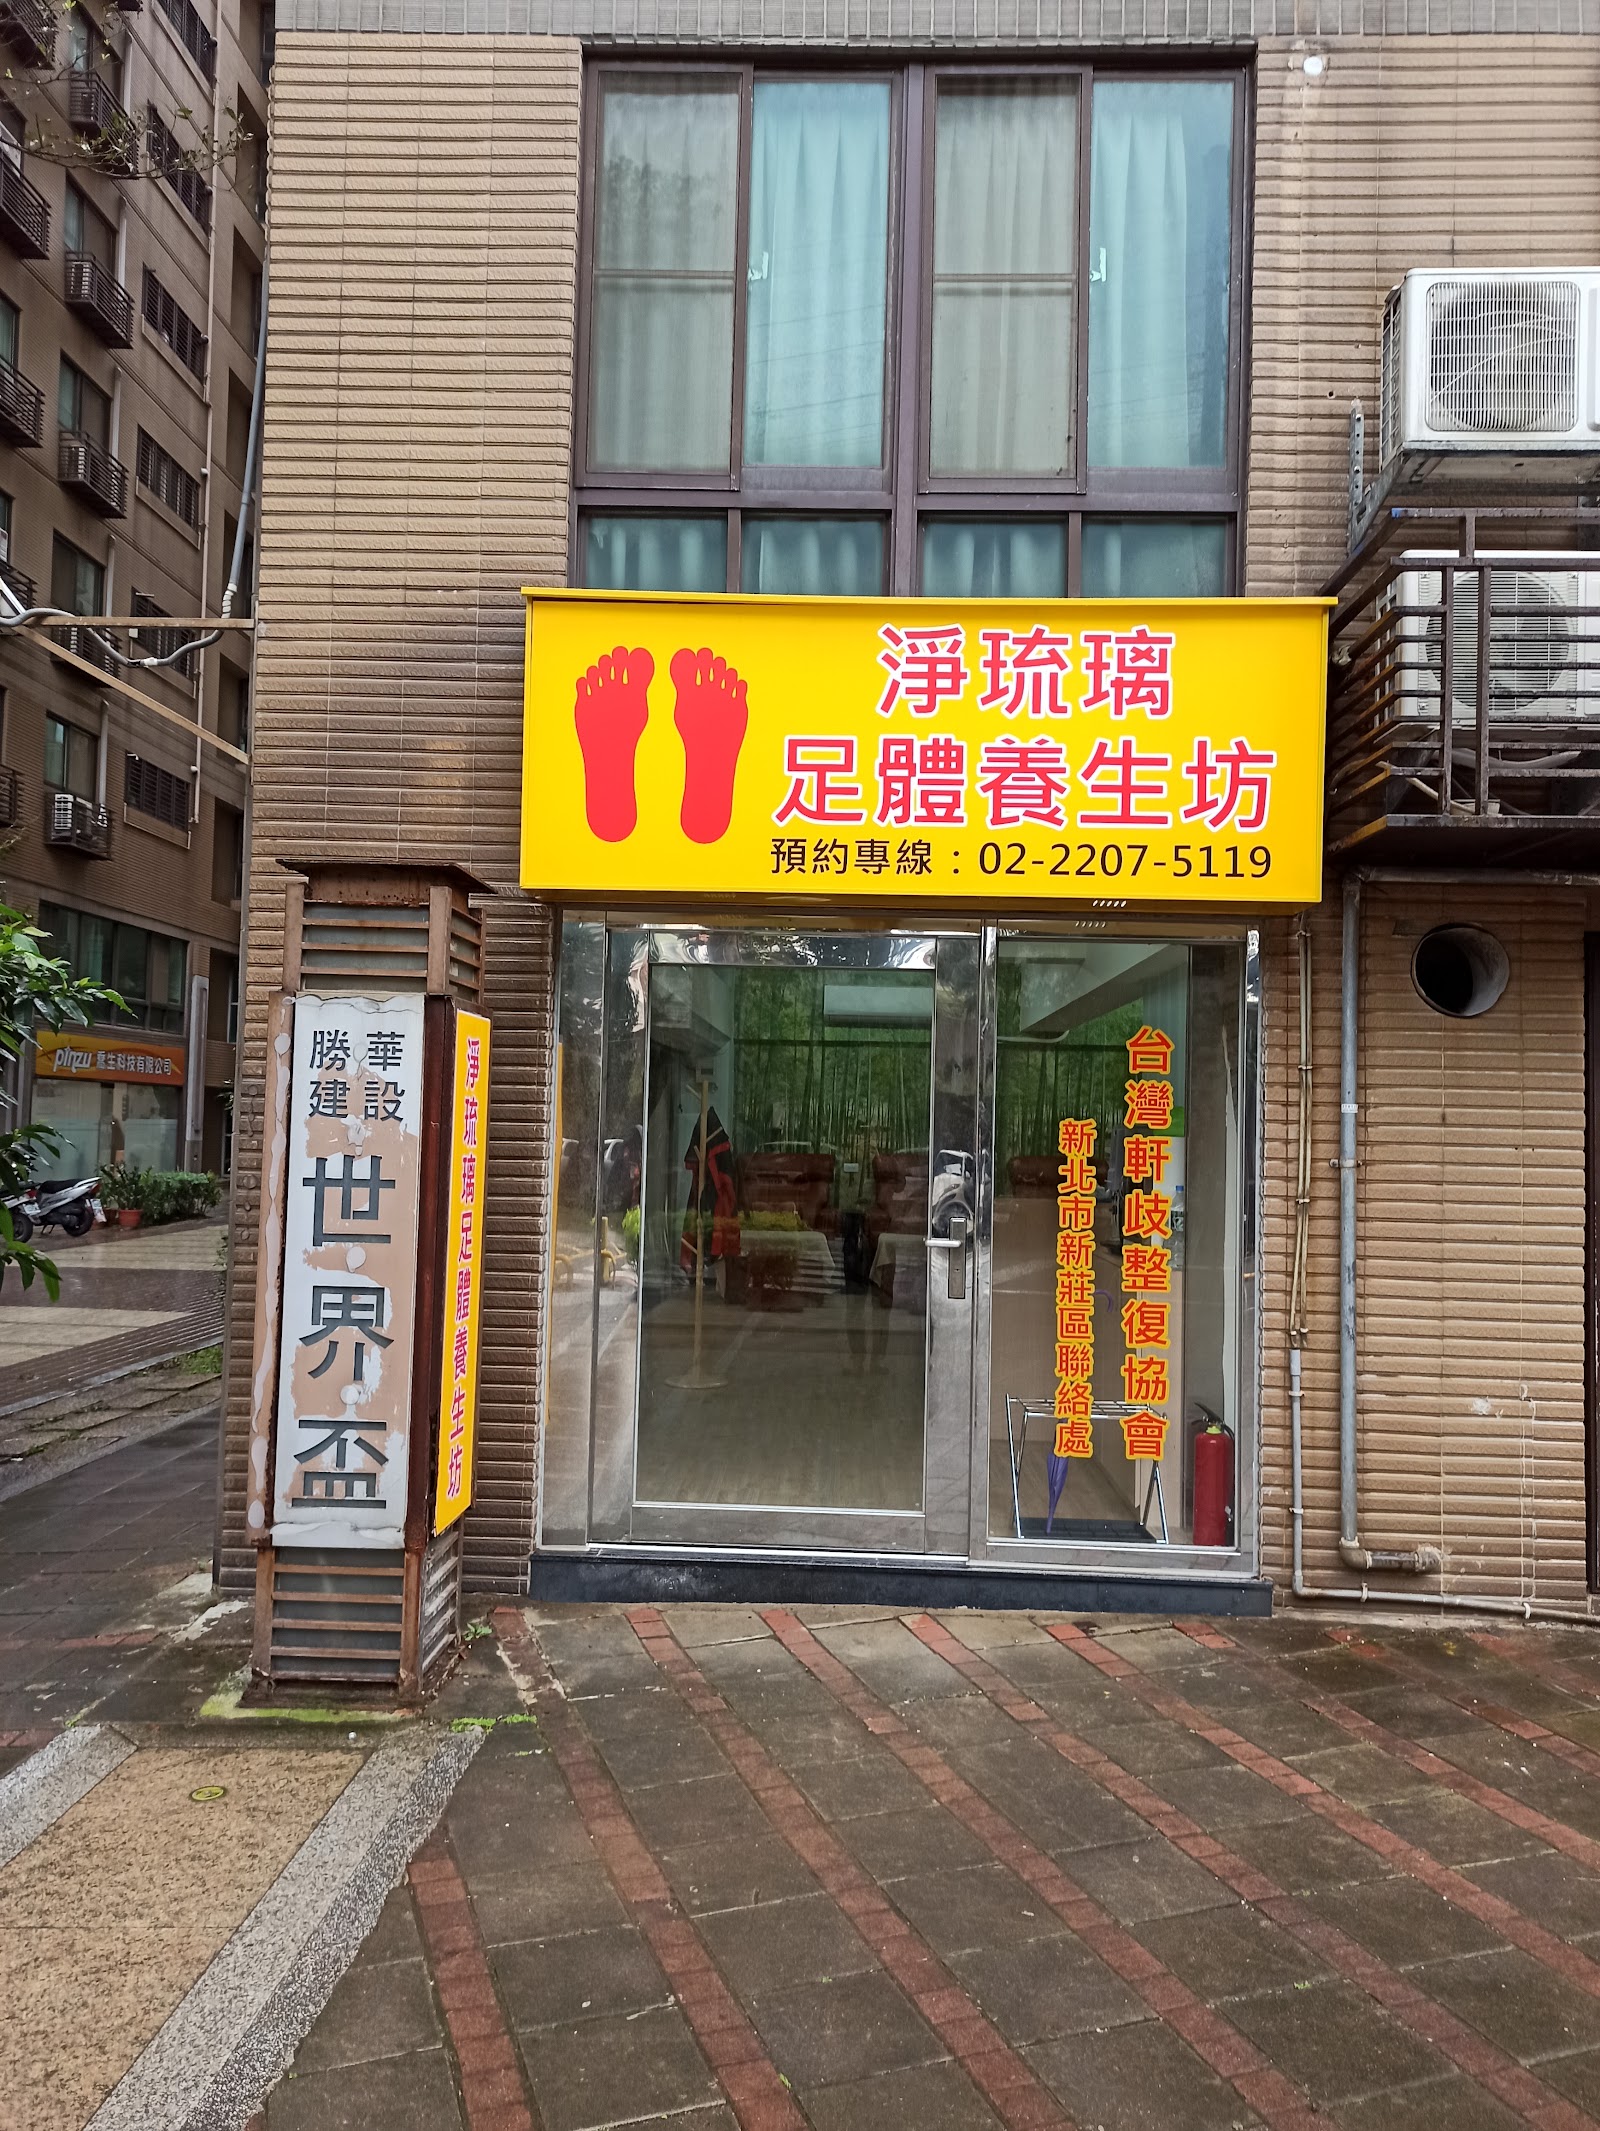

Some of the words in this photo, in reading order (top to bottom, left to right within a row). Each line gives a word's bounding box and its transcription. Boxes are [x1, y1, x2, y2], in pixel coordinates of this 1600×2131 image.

[876, 623, 1175, 720] 淨琉璃
[771, 733, 1278, 832] 足體養生坊
[307, 1078, 406, 1122] 建設
[308, 1028, 406, 1072] 勝華
[291, 1154, 396, 1510] 世界盃
[446, 1037, 481, 1498] 淨琉璃足體養生坊
[1054, 1117, 1097, 1458] 新北市新莊區聯絡處
[1121, 1025, 1175, 1460] 台灣軒歧整復協會
